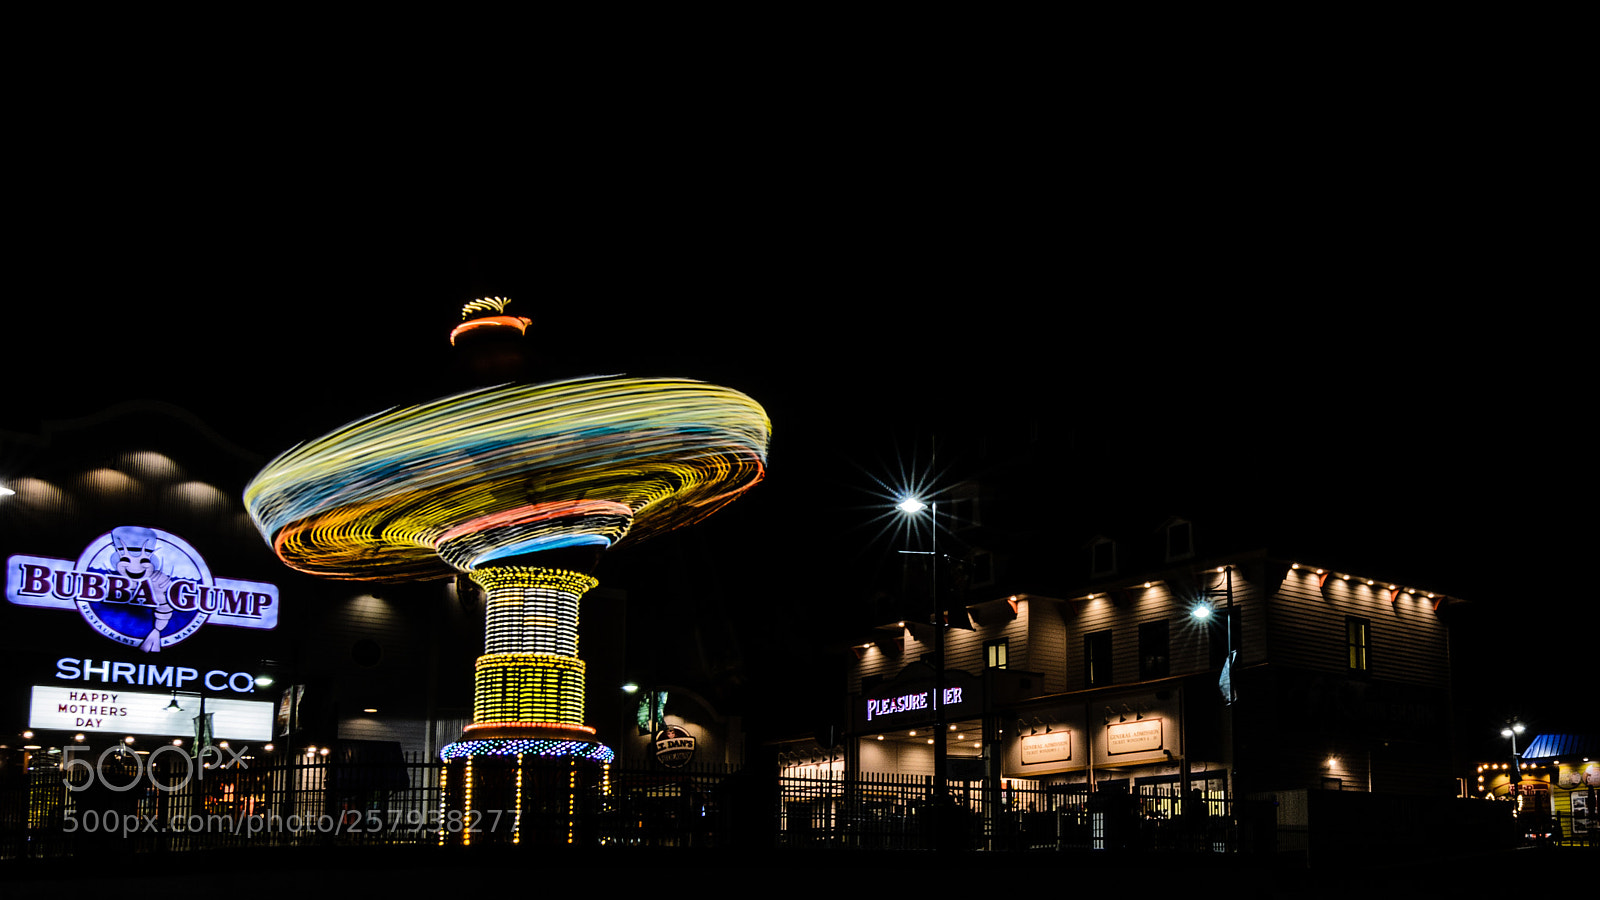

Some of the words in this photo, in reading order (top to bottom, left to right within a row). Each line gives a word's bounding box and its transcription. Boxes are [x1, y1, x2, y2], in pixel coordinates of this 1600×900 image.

[20, 564, 157, 607] BUBBA
[168, 579, 272, 617] GUMP
[56, 657, 199, 687] SHRIMP
[204, 670, 255, 692] CO.
[70, 691, 118, 703] HAPPY
[867, 691, 928, 721] PLEASURE
[58, 704, 127, 716] MOTHERS
[76, 717, 102, 728] DAY
